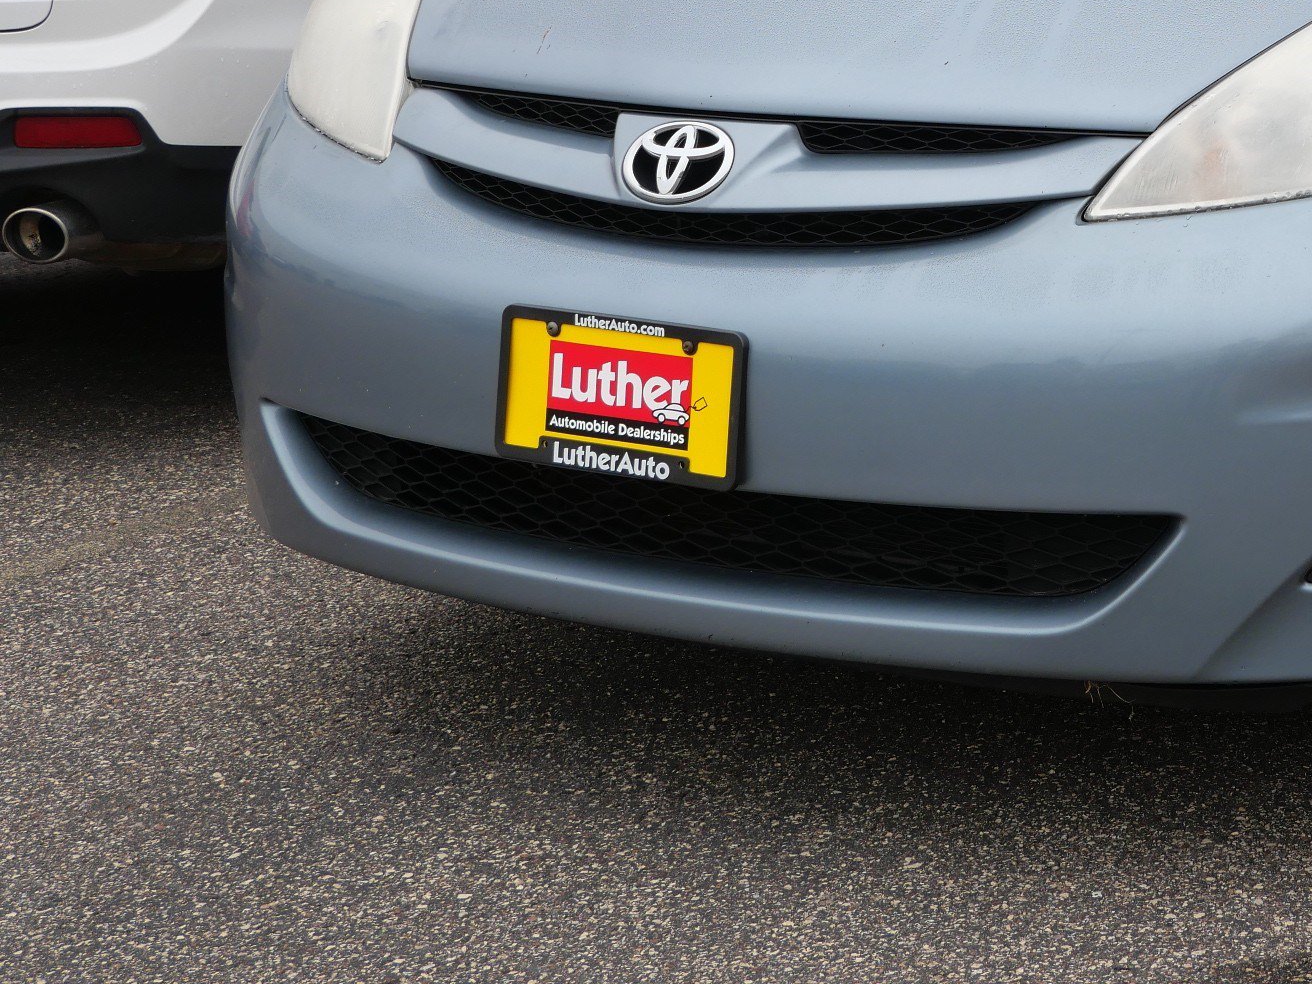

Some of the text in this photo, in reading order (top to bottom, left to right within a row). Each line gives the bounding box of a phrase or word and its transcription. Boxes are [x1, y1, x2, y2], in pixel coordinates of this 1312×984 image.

[574, 314, 665, 337] LutherAuto.com
[551, 352, 690, 411] Luther
[549, 414, 685, 446] Automobile Dealerships
[552, 441, 670, 480] LutherAuto
